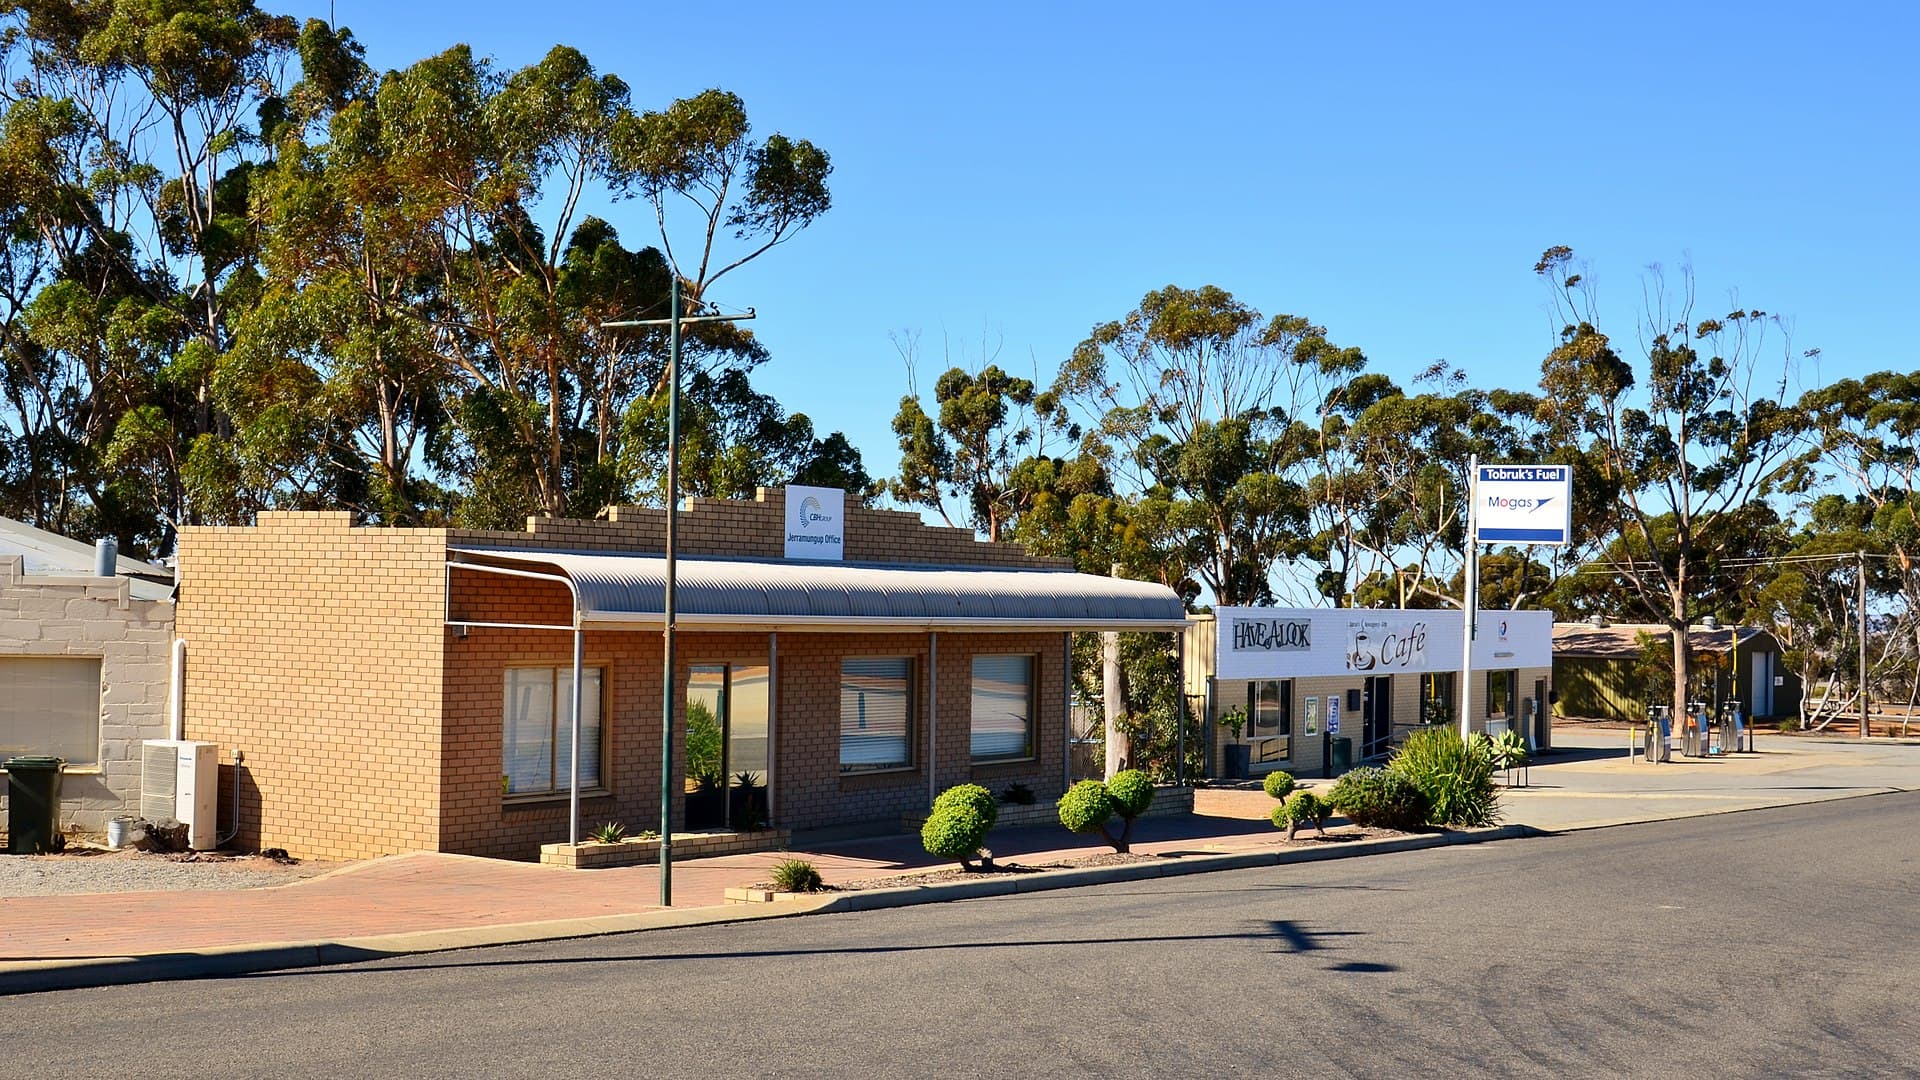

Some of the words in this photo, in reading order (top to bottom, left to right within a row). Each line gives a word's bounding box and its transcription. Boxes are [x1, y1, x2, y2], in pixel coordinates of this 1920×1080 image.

[1487, 469, 1533, 480] Tobruk's
[1536, 469, 1559, 480] Fuel
[1488, 496, 1532, 510] Mogas
[787, 533, 824, 544] Jerramungup
[825, 534, 841, 544] Office
[1234, 622, 1267, 649] HAVE
[1264, 620, 1281, 649] A
[1279, 622, 1311, 648] LOOK
[1381, 622, 1426, 667] Café
